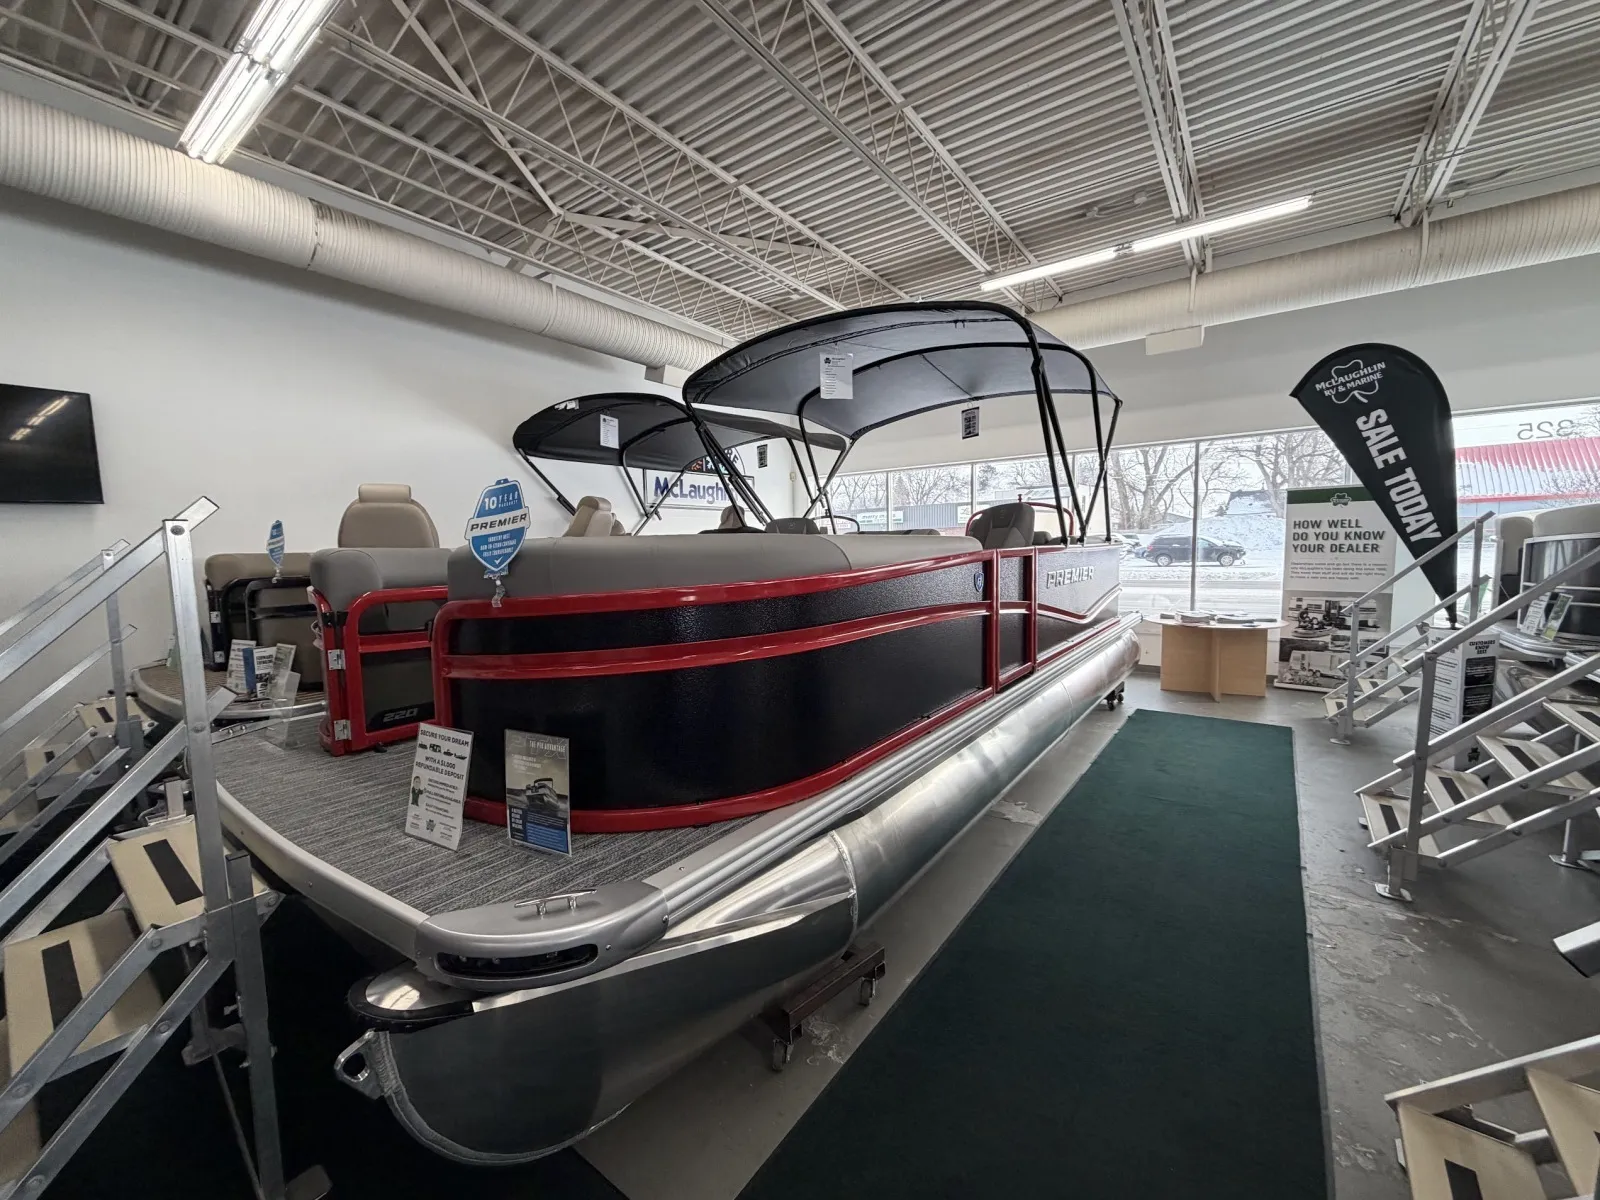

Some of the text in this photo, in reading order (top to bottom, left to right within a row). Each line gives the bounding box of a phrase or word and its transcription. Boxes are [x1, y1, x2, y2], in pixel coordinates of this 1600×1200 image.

[1323, 371, 1384, 397] RV & MARINE
[1355, 408, 1442, 543] SALE TODAY
[484, 491, 519, 510] 10 YEAR
[470, 512, 527, 532] PREMIER
[1293, 518, 1362, 530] HOW WELL
[1292, 530, 1386, 541] DO YOU KNOW
[1292, 543, 1381, 553] YOUR DEALER
[1046, 565, 1094, 589] PREMIER
[383, 707, 418, 723] 220
[420, 729, 470, 747] SECURE YOUR DREAM
[444, 770, 465, 780] DEPOSIT
